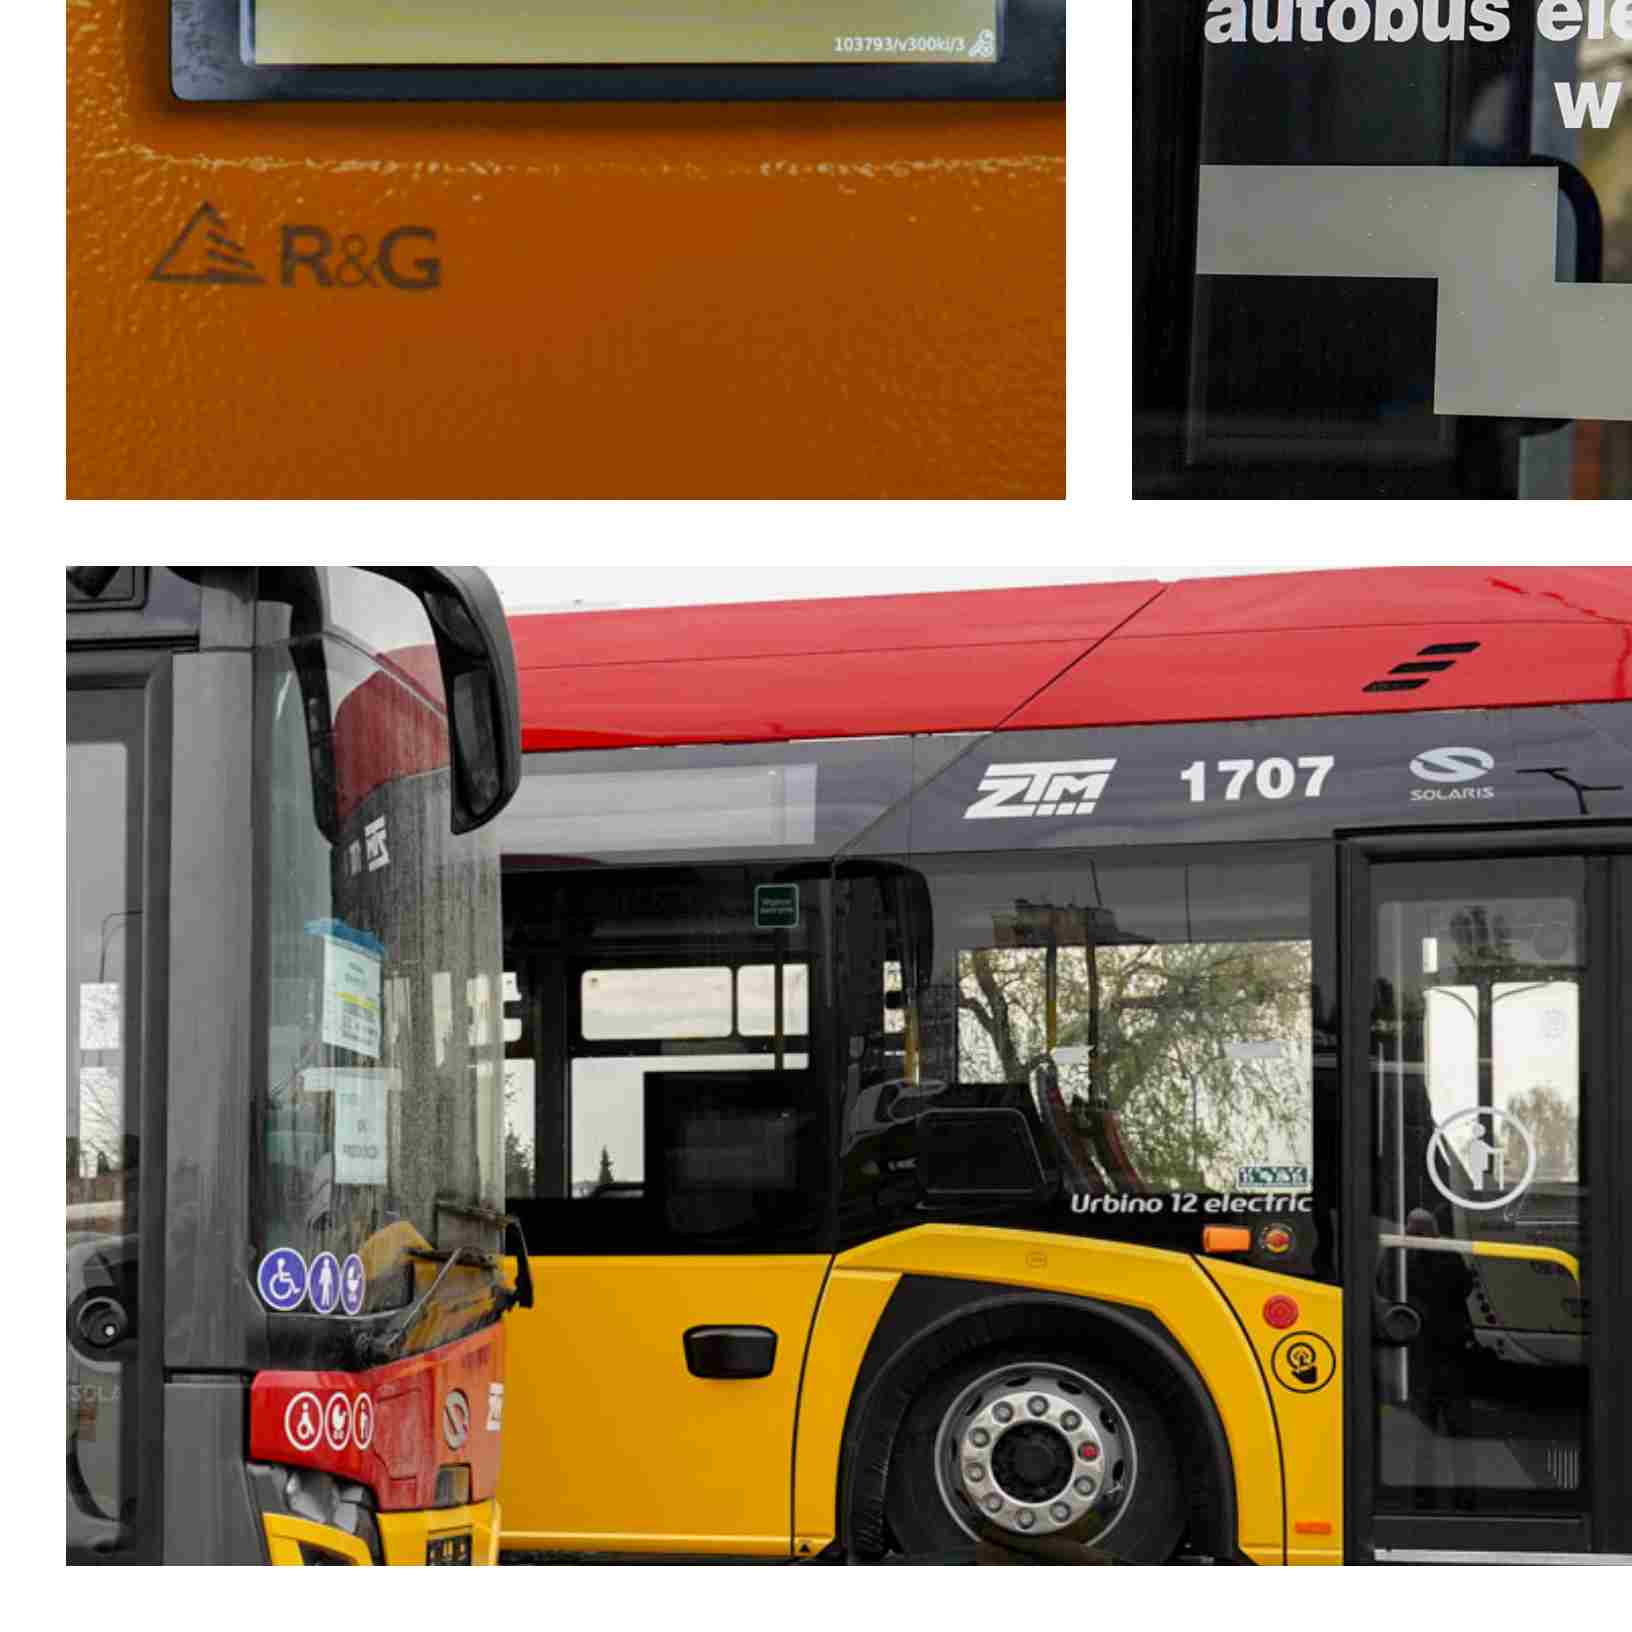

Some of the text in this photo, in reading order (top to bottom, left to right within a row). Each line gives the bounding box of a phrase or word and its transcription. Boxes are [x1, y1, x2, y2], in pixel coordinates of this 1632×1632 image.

[1555, 81, 1616, 129] w
[280, 227, 442, 290] R&G
[963, 756, 1494, 819] ZTM 1707 SOLARIS
[1071, 1193, 1313, 1214] Urbino 12 electric
